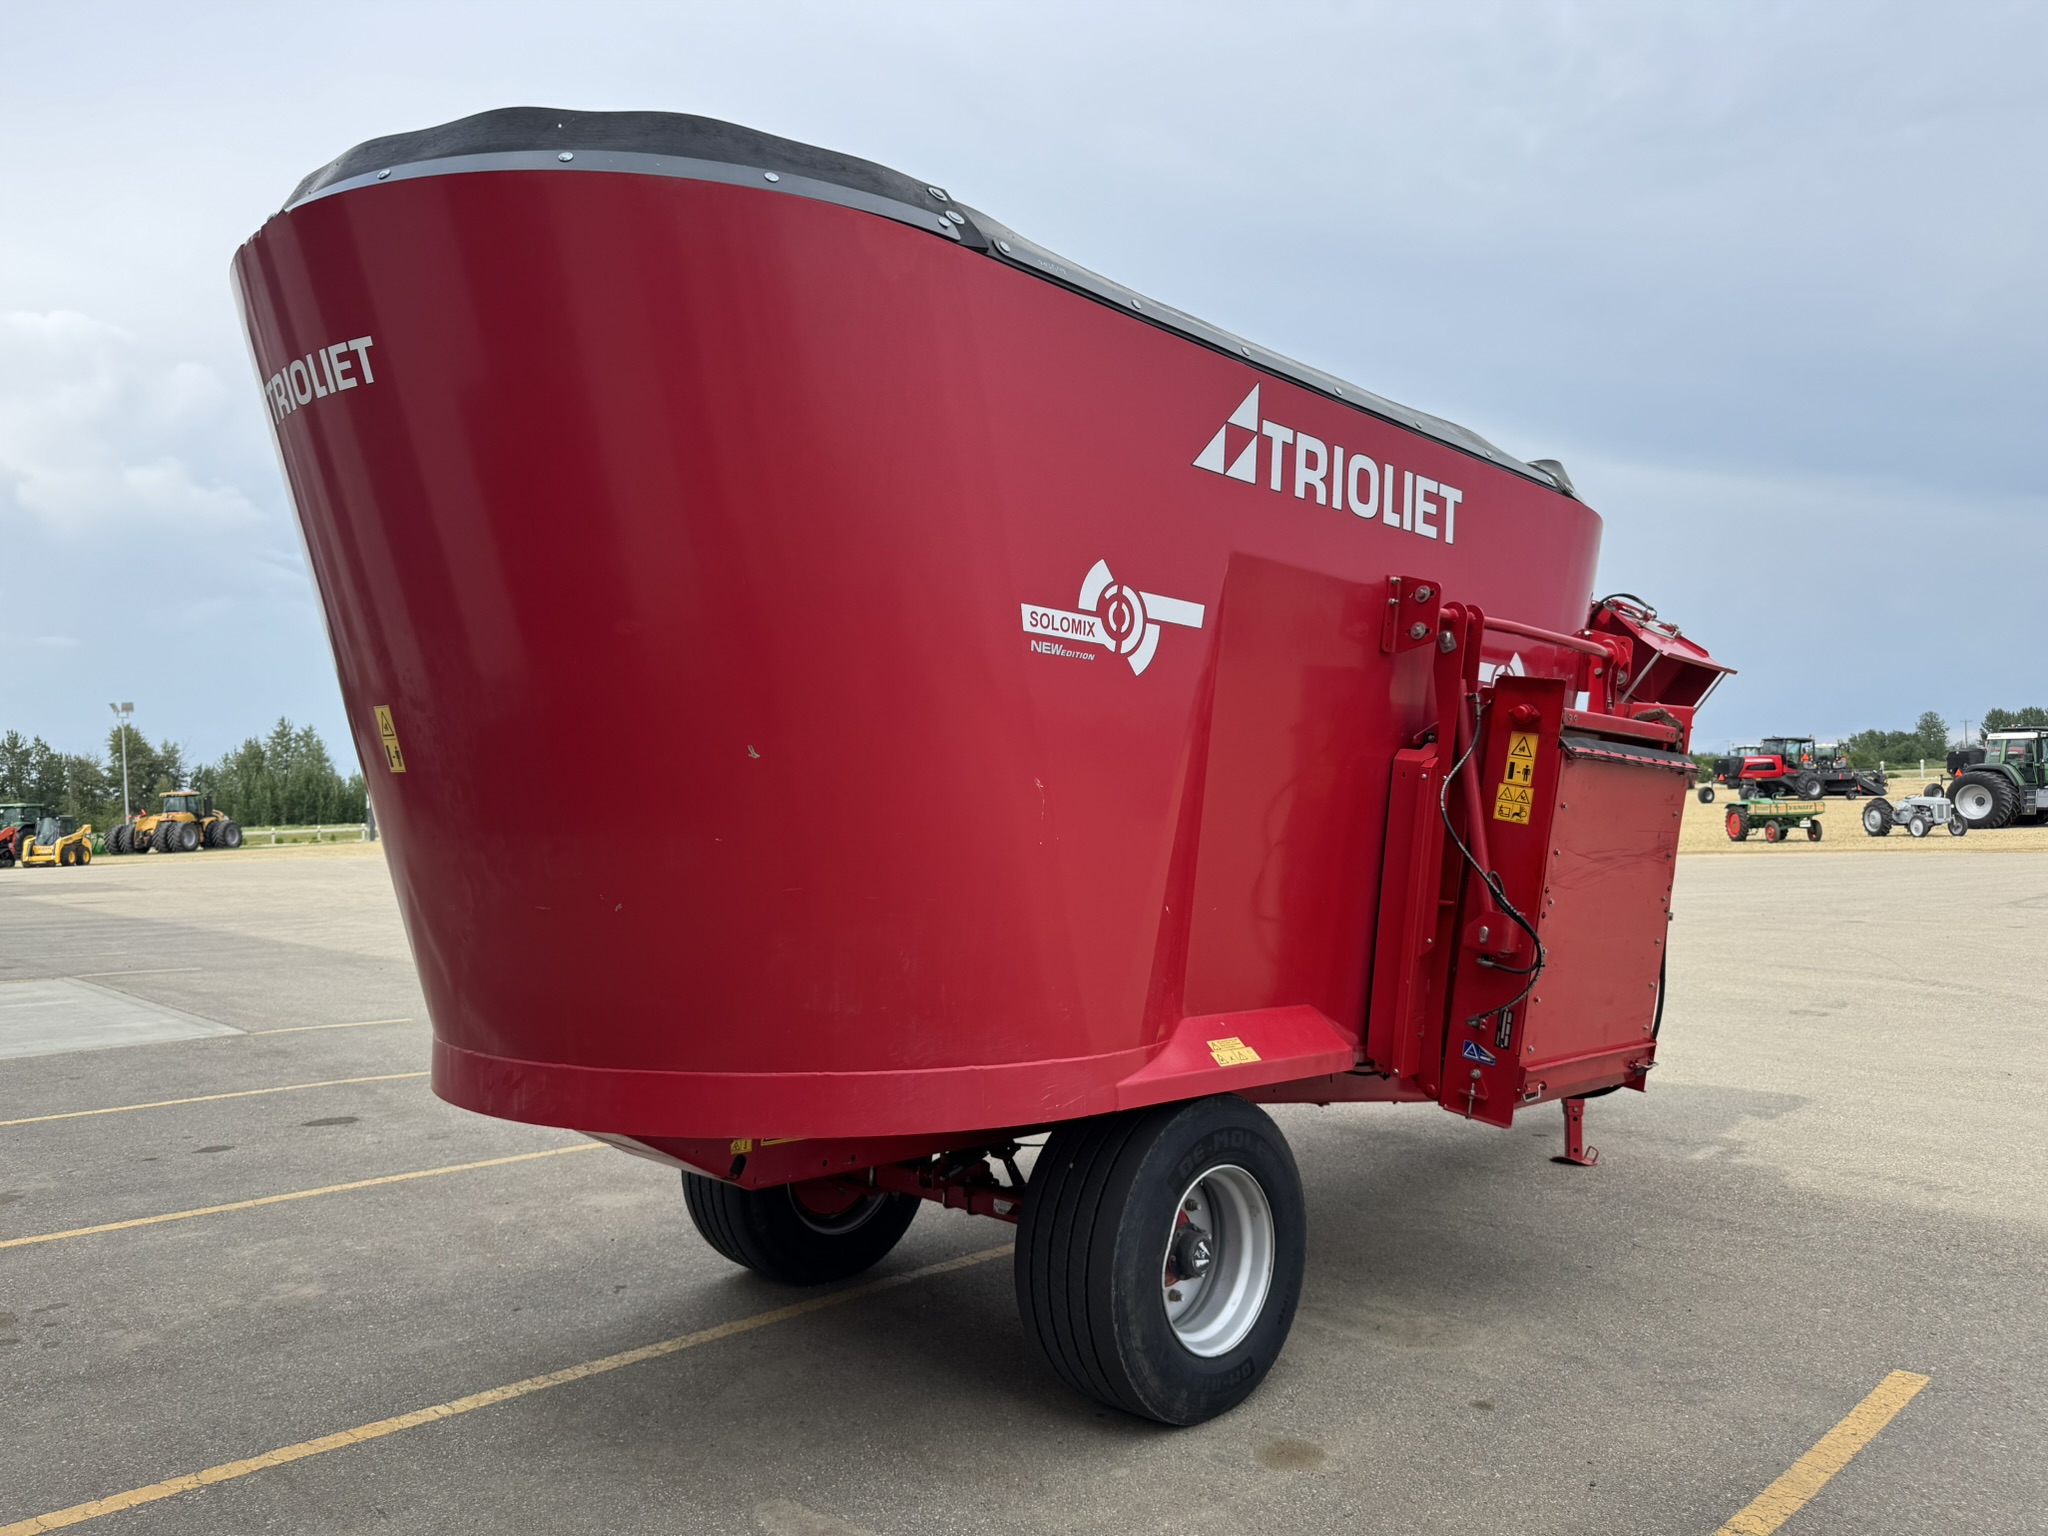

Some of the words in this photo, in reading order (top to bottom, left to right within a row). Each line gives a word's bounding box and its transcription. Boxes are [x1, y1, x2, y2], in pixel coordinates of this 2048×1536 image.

[265, 335, 375, 425] TRIOLIET
[1262, 419, 1463, 545] TRIOLIET
[1029, 611, 1096, 637] SOLOMIX
